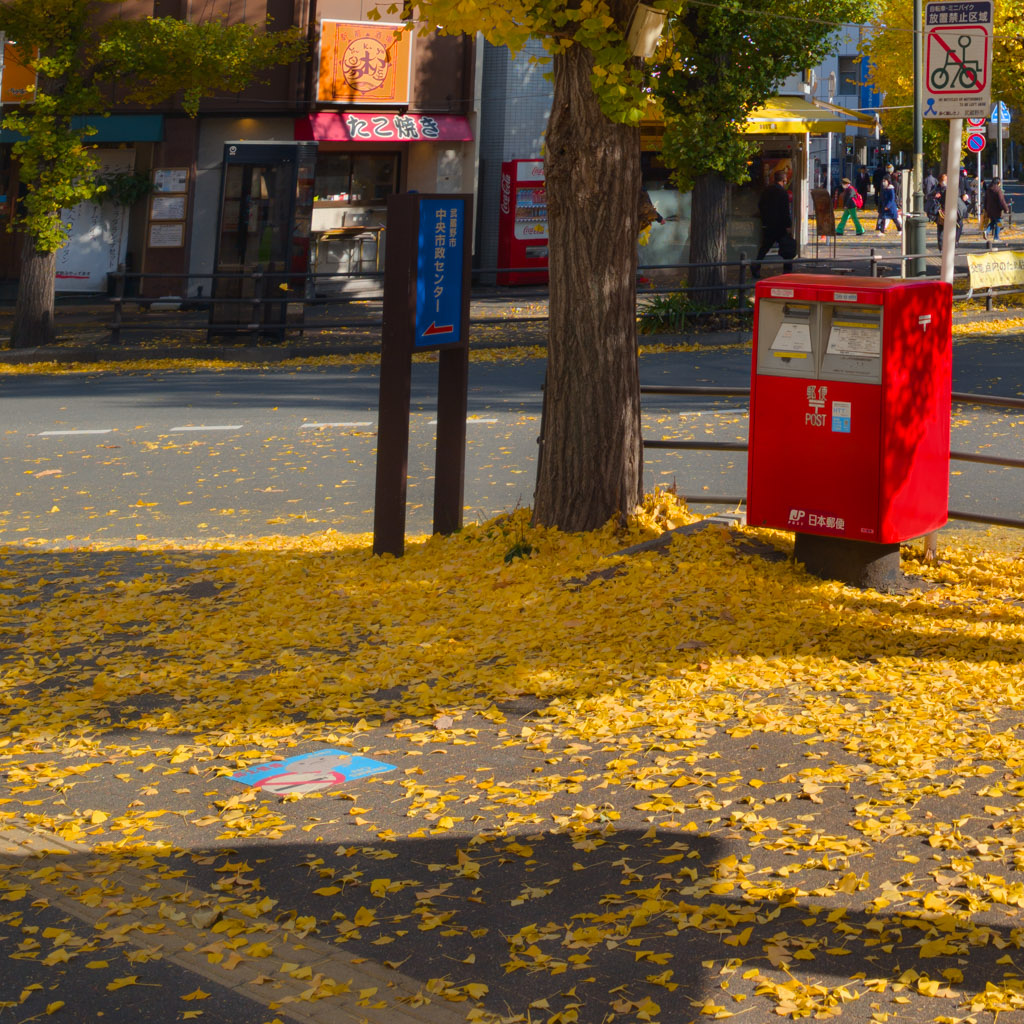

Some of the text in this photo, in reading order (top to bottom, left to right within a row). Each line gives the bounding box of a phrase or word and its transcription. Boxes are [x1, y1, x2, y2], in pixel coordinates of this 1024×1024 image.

[929, 11, 989, 25] 放置禁止区域
[346, 114, 440, 139] たこ焼き
[448, 208, 458, 248] 武蔵野市
[433, 208, 447, 313] 中央市政センター
[806, 385, 828, 402] 郵便
[805, 413, 827, 427] POST
[808, 514, 845, 531] 日本郵便
